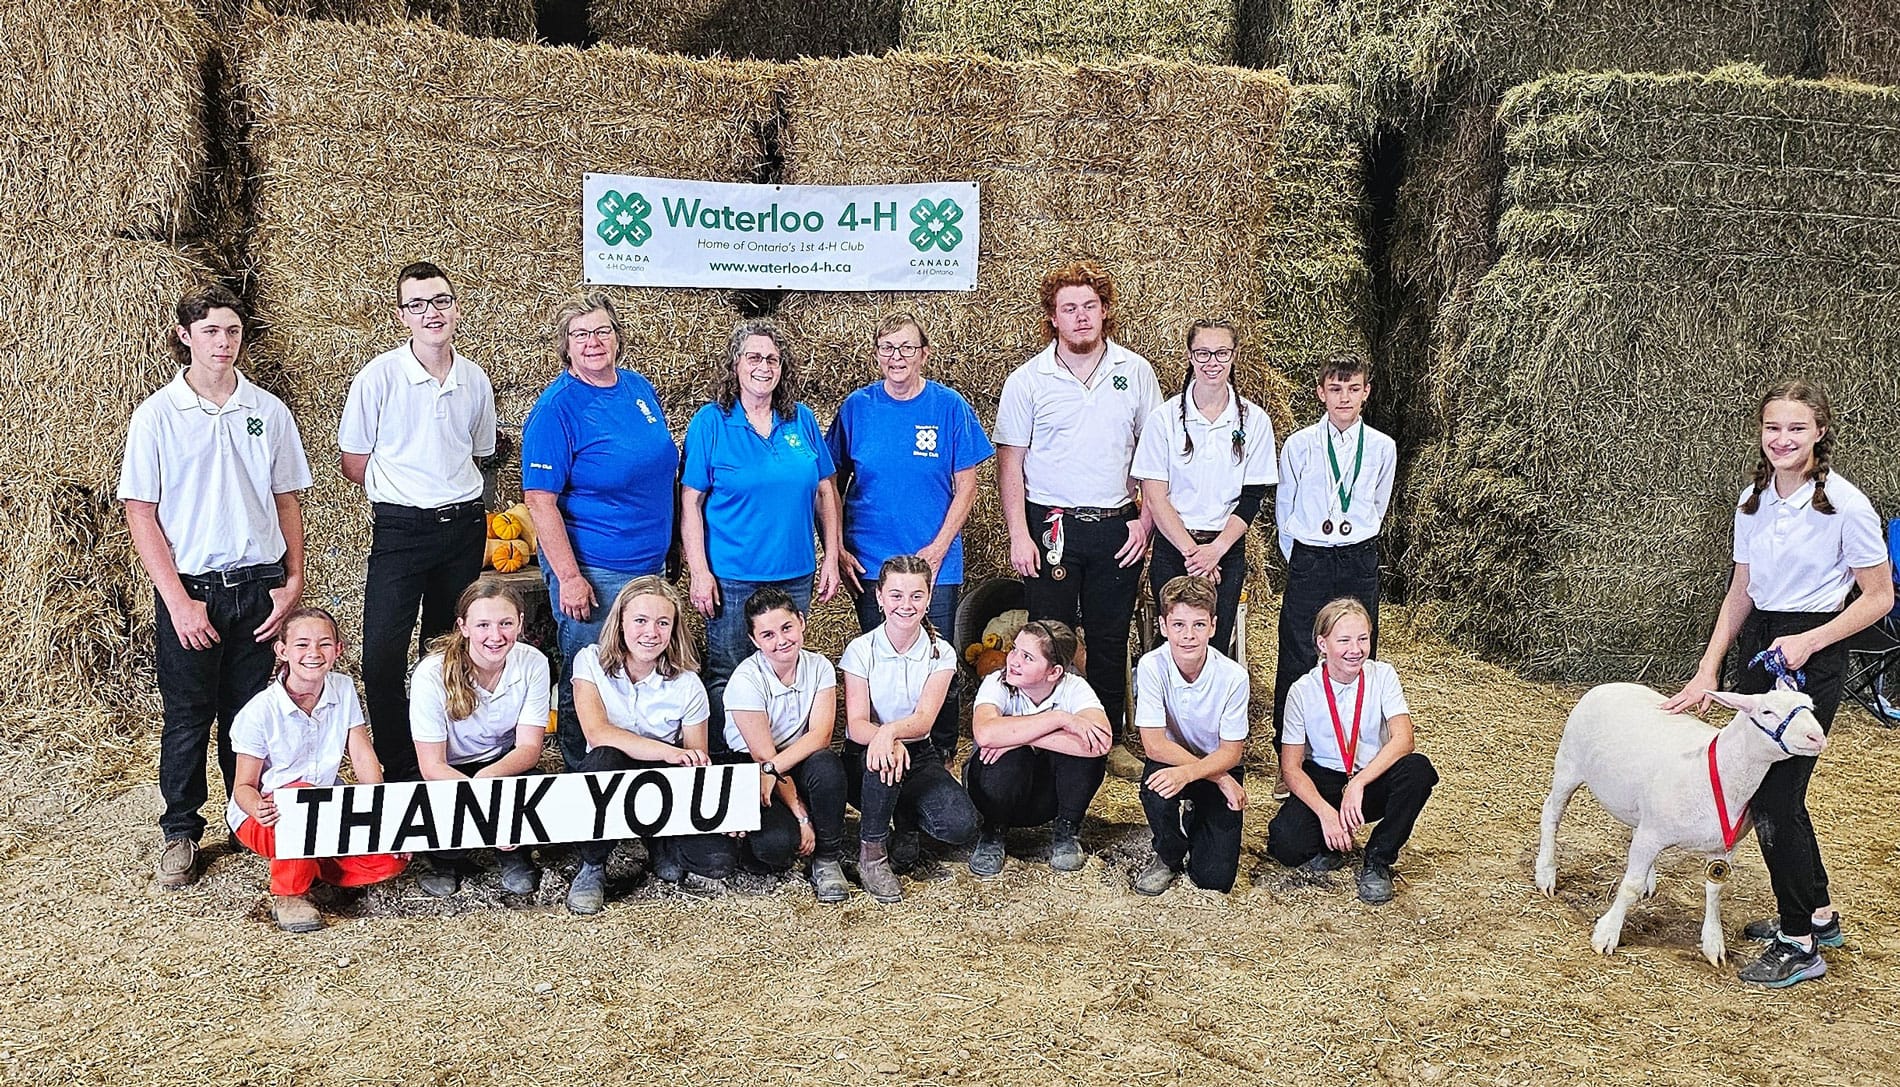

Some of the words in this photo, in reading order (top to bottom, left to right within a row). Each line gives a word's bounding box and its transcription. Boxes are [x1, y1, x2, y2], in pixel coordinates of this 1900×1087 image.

[662, 196, 824, 233] Waterloo
[837, 201, 897, 232] 4-H
[697, 238, 730, 249] Home
[733, 240, 746, 250] of
[747, 241, 796, 253] Ontario's
[800, 242, 815, 252] 1st
[818, 241, 837, 251] 4-H
[840, 241, 865, 252] Club
[598, 252, 650, 263] CANADA
[909, 259, 960, 267] CANADA
[709, 261, 851, 274] www.waterloo4-h.ca
[296, 775, 558, 856] THANK
[583, 766, 734, 838] YOU
